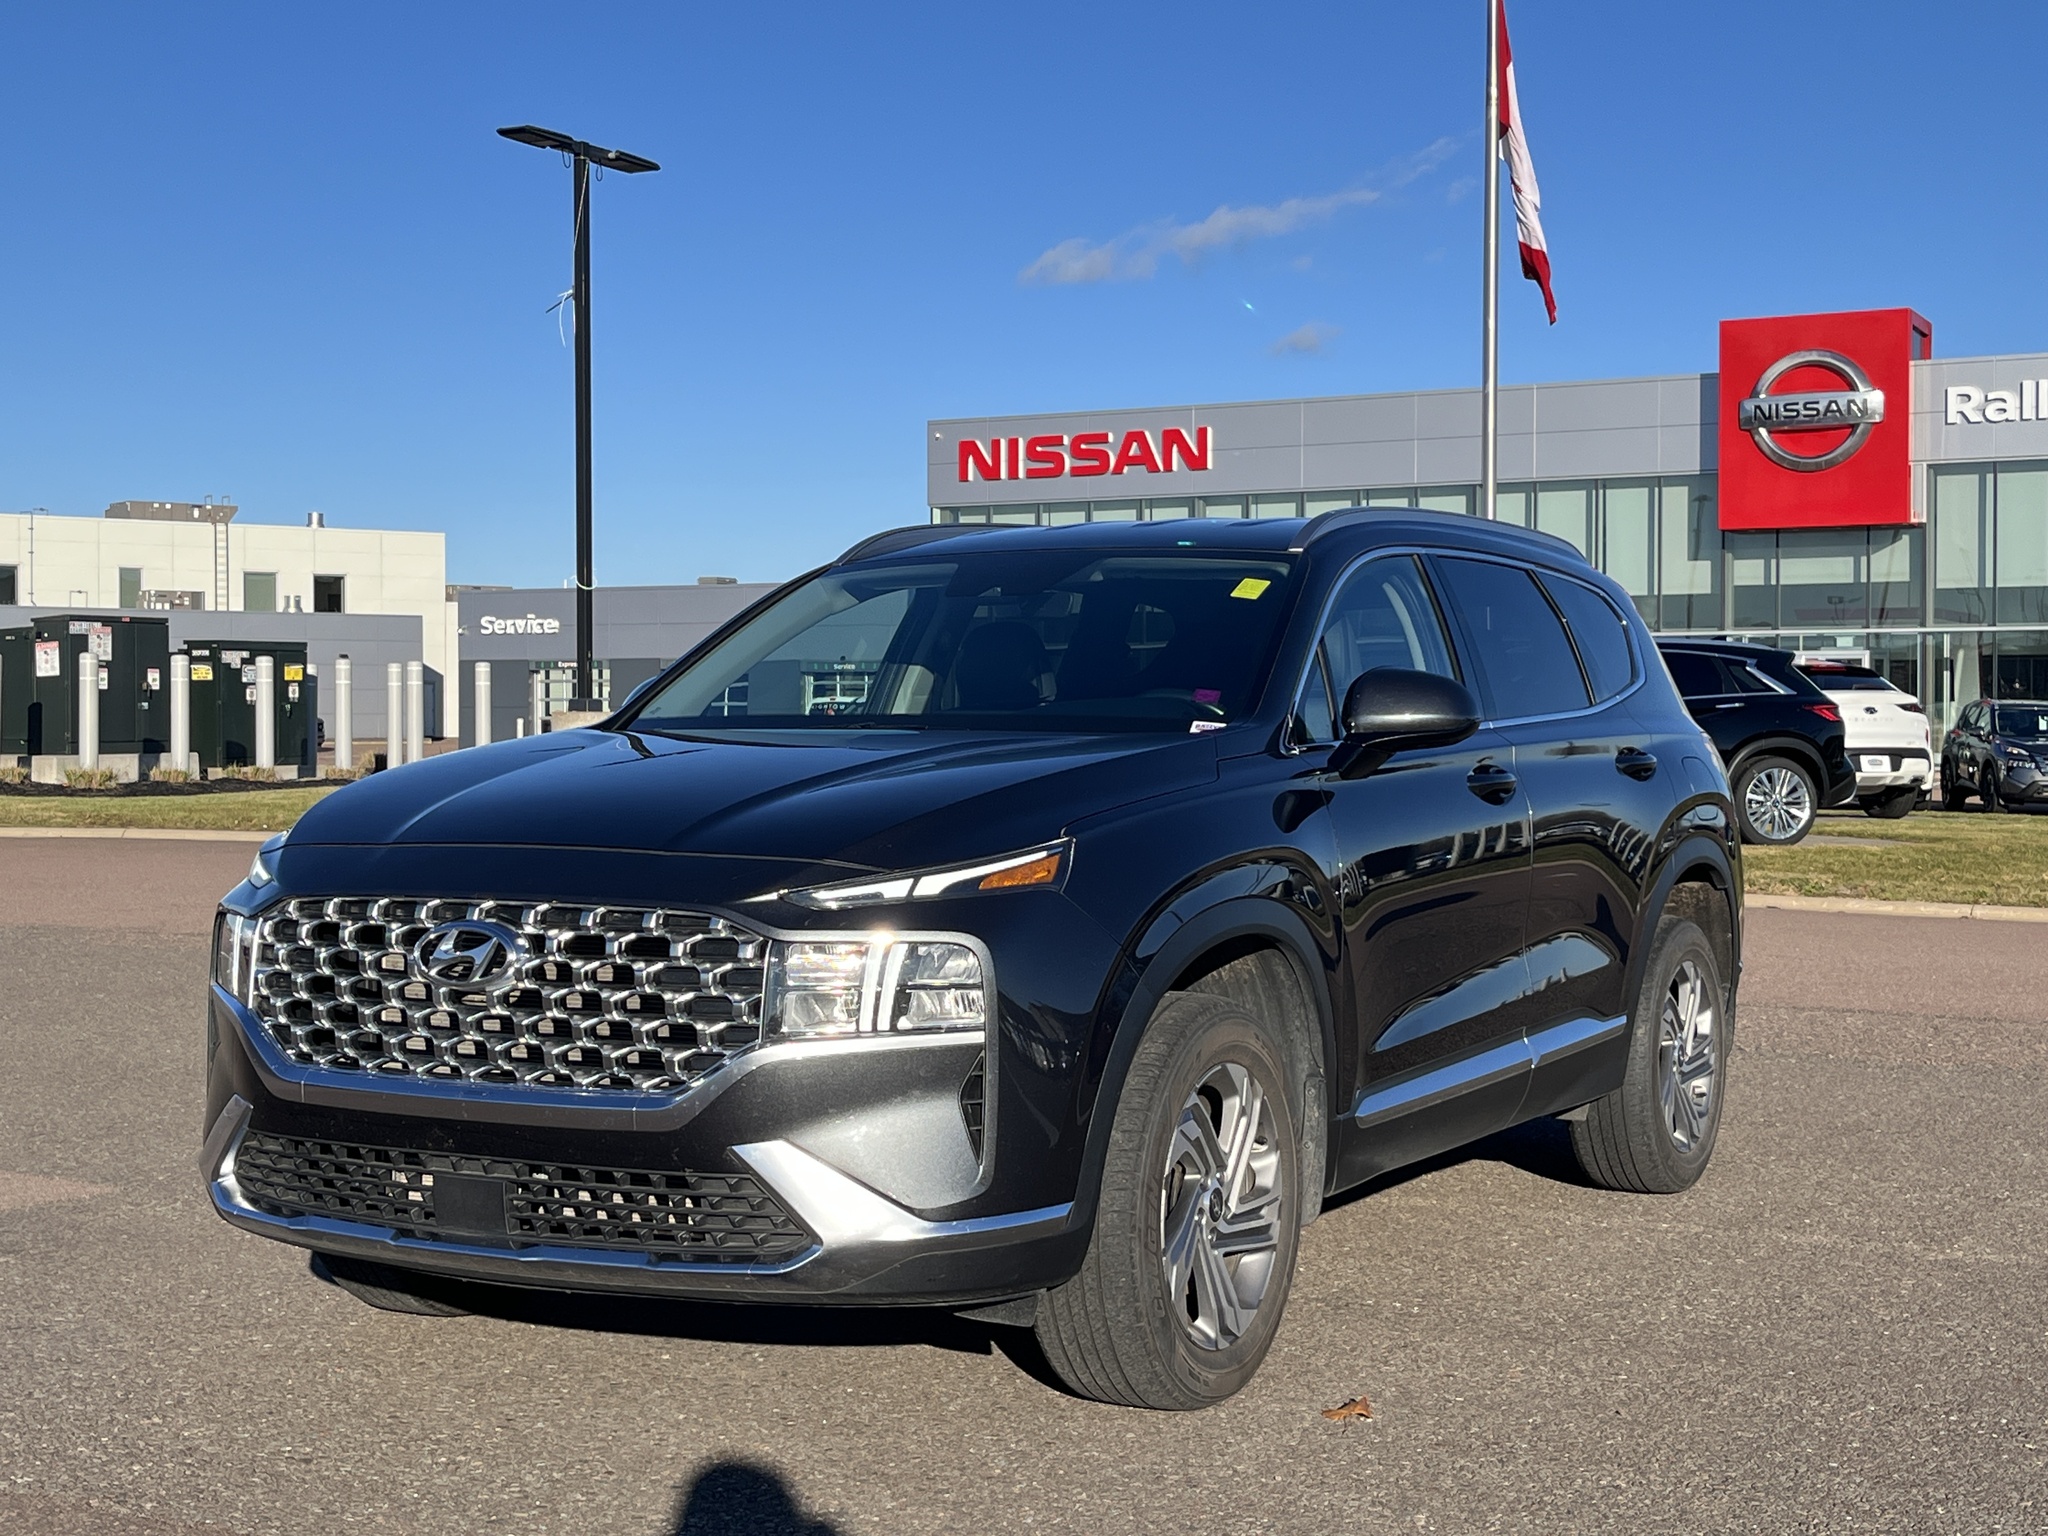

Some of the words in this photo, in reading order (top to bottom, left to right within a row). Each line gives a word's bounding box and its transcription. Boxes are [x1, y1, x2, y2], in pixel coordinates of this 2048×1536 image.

[1753, 398, 1868, 422] NISSAN
[1945, 379, 2048, 425] Rall
[958, 426, 1212, 482] NISSAN
[480, 613, 559, 634] Service
